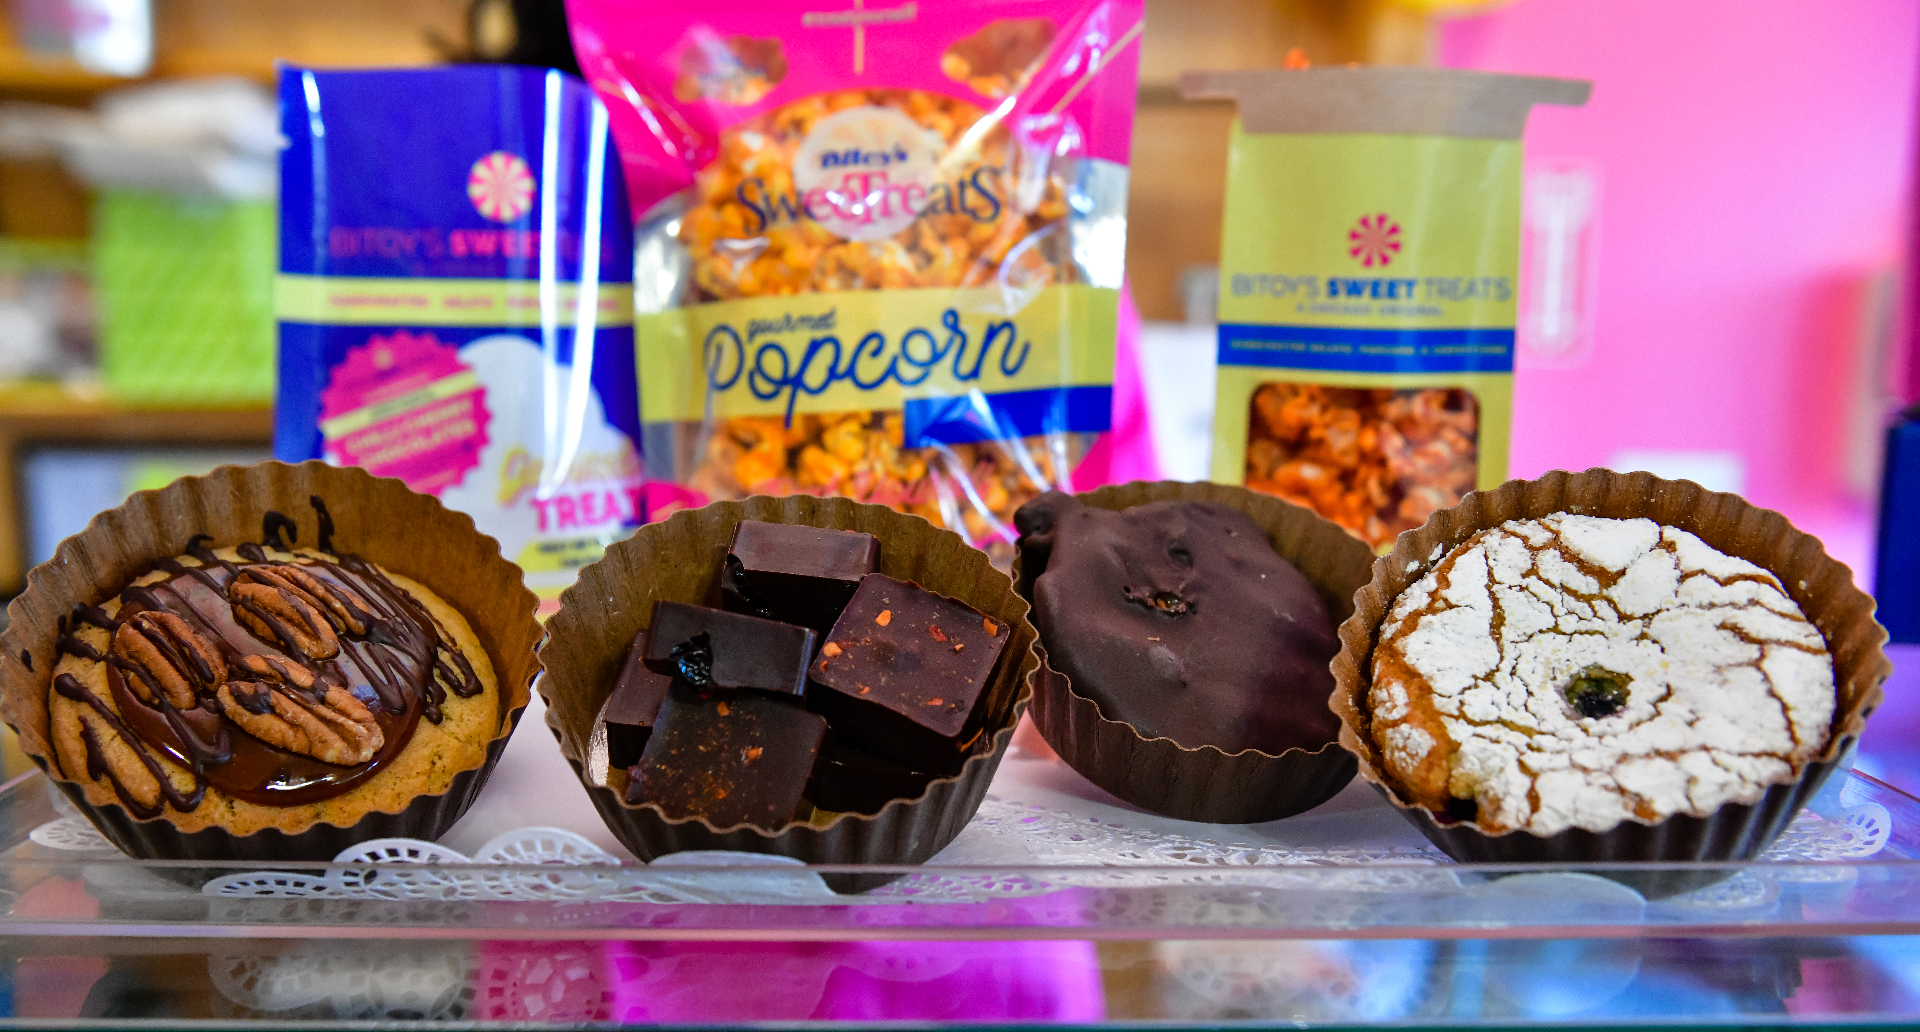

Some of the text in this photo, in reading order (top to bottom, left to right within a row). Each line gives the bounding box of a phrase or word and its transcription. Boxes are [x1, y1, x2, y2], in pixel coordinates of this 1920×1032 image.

[1231, 274, 1512, 302] BITOY'S SWEET TREATS
[703, 308, 1031, 430] Popcorn
